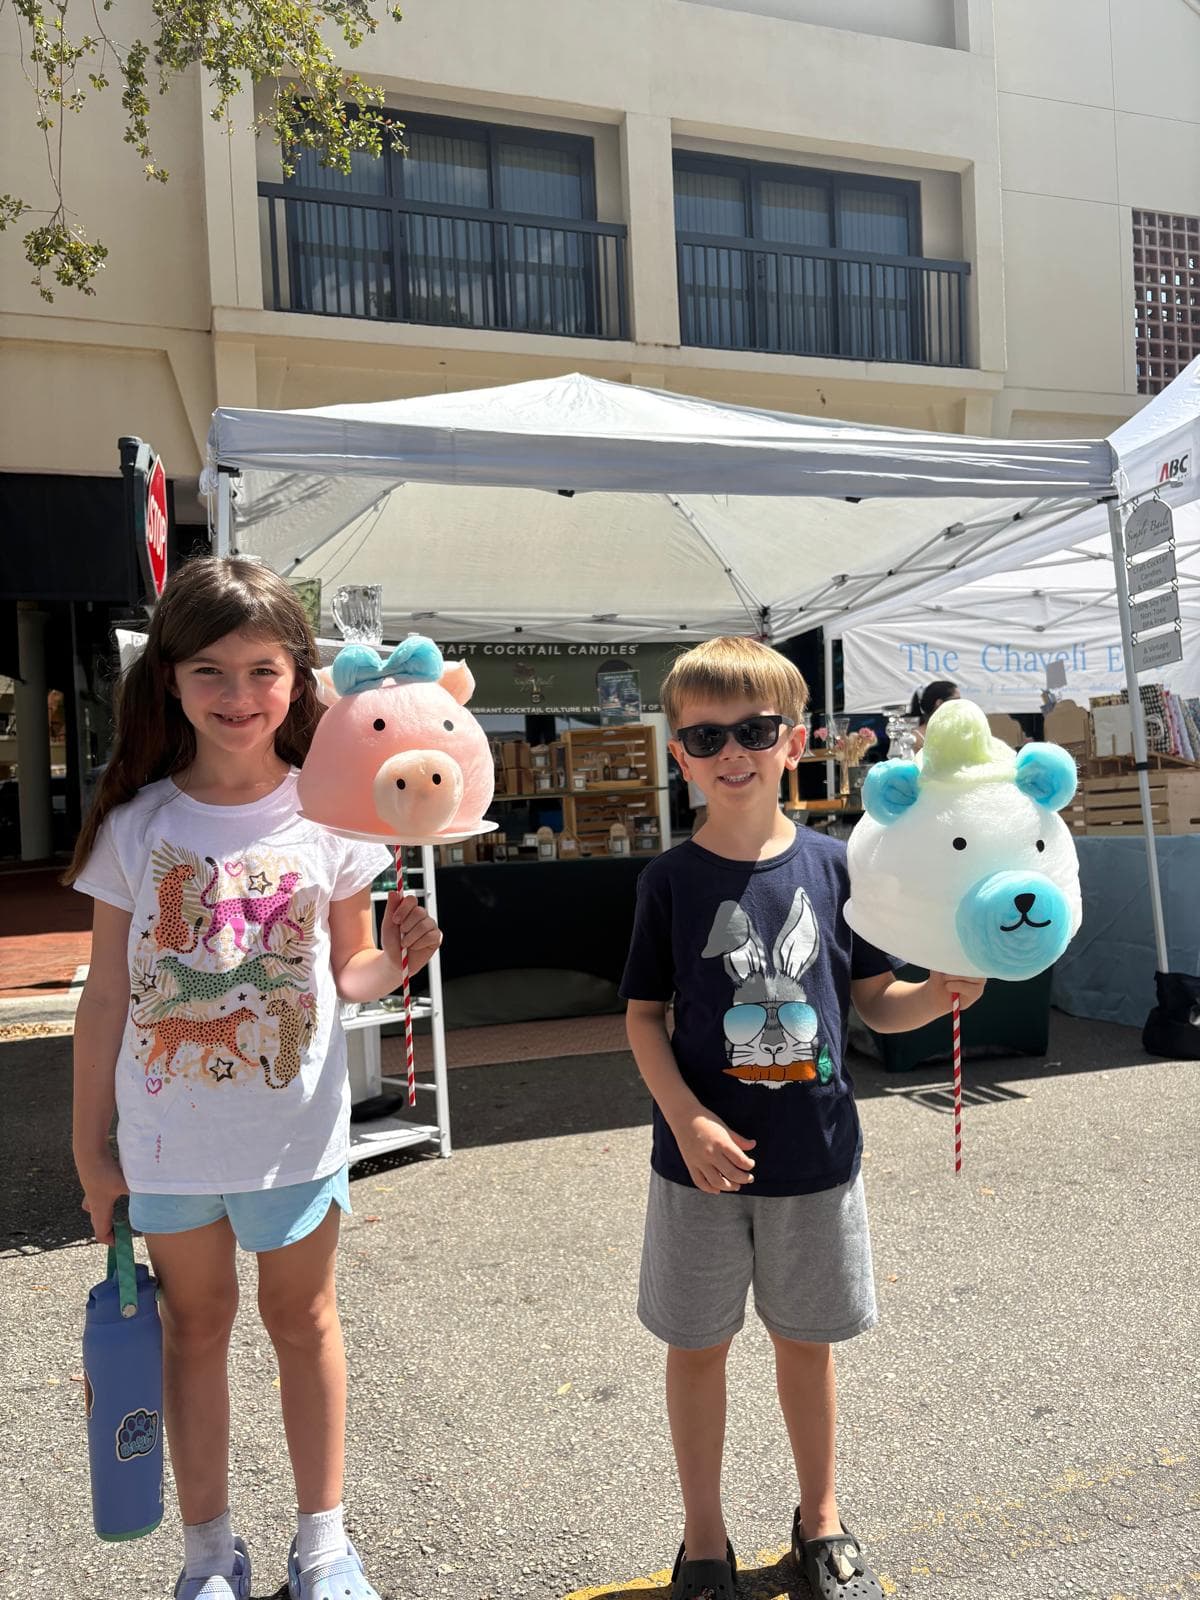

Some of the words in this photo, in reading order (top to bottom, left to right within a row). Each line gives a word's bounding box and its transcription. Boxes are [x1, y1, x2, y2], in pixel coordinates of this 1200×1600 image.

[1159, 454, 1189, 482] ABC
[149, 494, 167, 560] STOP
[437, 645, 477, 655] RAFT
[483, 645, 561, 655] COCKTAIL
[567, 645, 637, 655] CANDLES
[900, 642, 960, 673] The
[981, 642, 1088, 673] Chaveli
[504, 706, 543, 714] COCKTAIL
